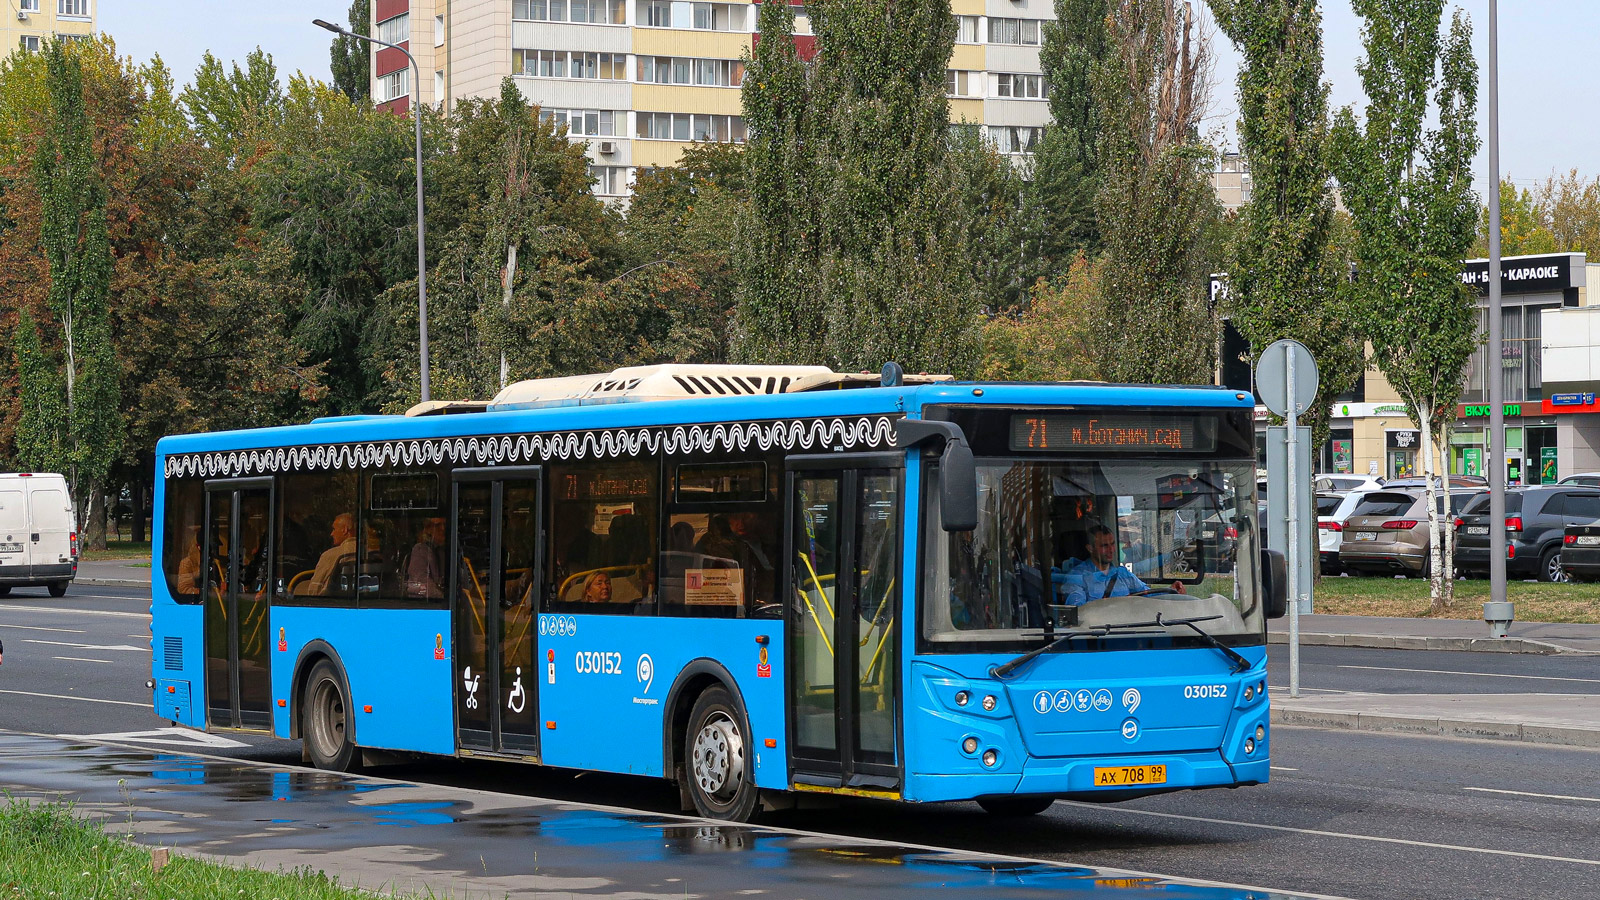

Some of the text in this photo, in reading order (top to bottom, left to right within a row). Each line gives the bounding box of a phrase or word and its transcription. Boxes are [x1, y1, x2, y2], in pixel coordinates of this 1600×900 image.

[1508, 266, 1559, 280] КАРАОКЕ
[1026, 419, 1047, 448] 71
[690, 576, 697, 587] 71
[575, 651, 622, 674] 030152
[1184, 685, 1227, 698] 030152
[1122, 768, 1144, 783] 708
[1151, 766, 1163, 777] 99
